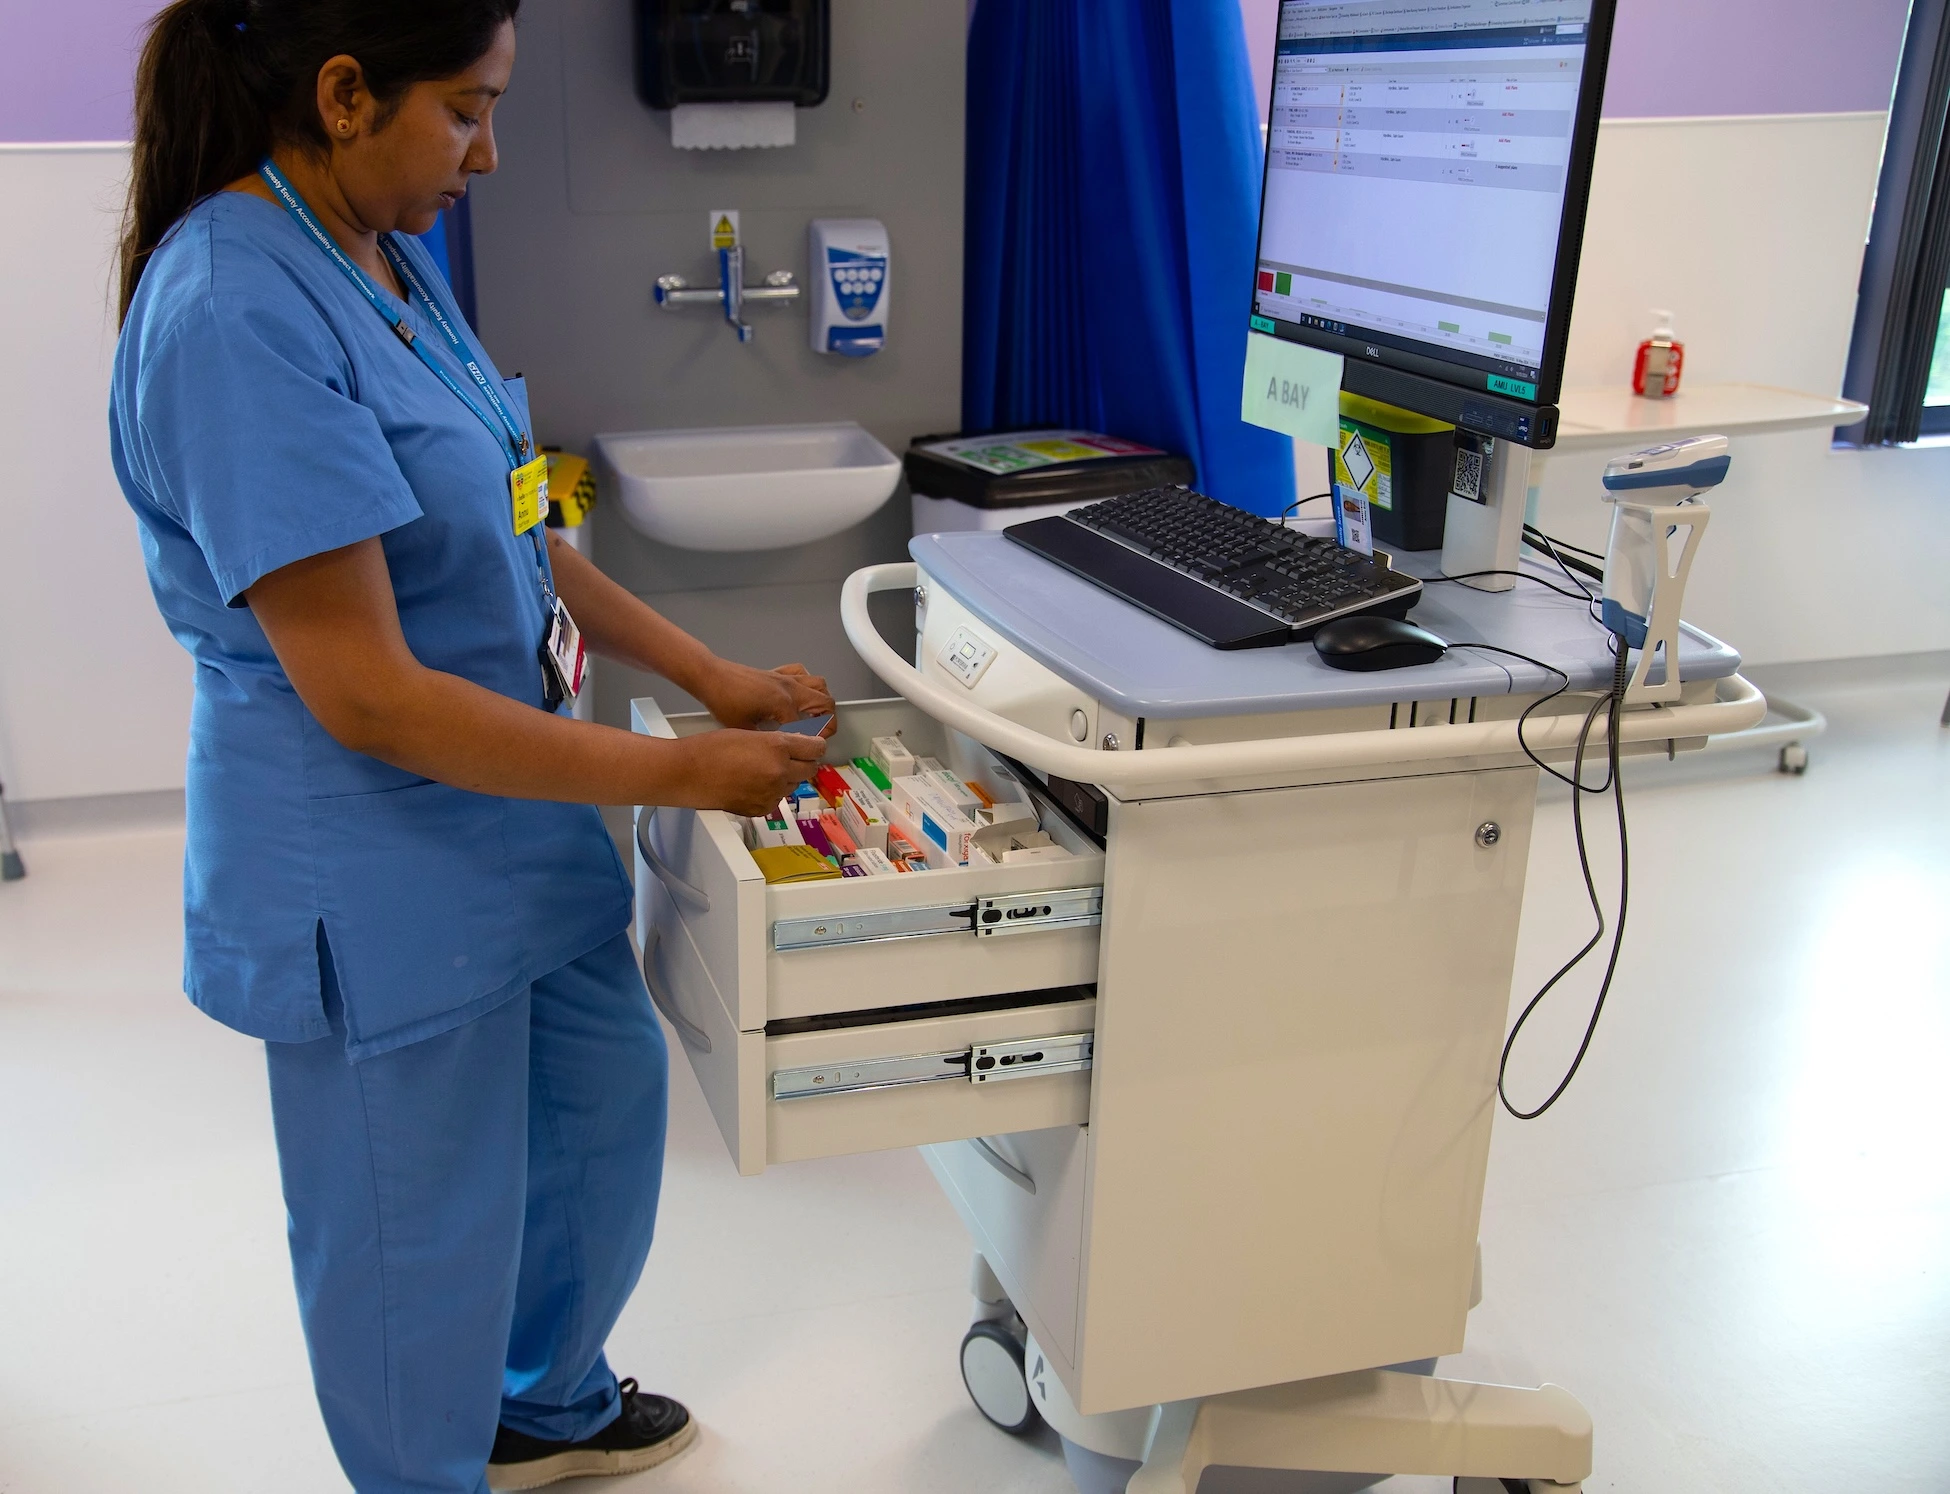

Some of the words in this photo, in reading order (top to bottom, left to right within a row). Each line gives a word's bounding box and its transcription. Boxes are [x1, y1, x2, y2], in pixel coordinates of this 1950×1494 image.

[263, 165, 283, 189] Honesty
[280, 187, 298, 209] Equity
[296, 207, 332, 250] Accountability
[330, 248, 352, 271] Respect
[384, 239, 402, 263] Respect
[400, 260, 431, 303] Accountability
[428, 301, 444, 323] Equity
[440, 320, 460, 346] Honesty
[1366, 346, 1379, 358] DELL
[469, 362, 486, 384] NHS
[1267, 376, 1277, 402] A
[1281, 379, 1310, 411] BAY
[1493, 380, 1508, 391] AMU
[1510, 383, 1526, 395] LVL5
